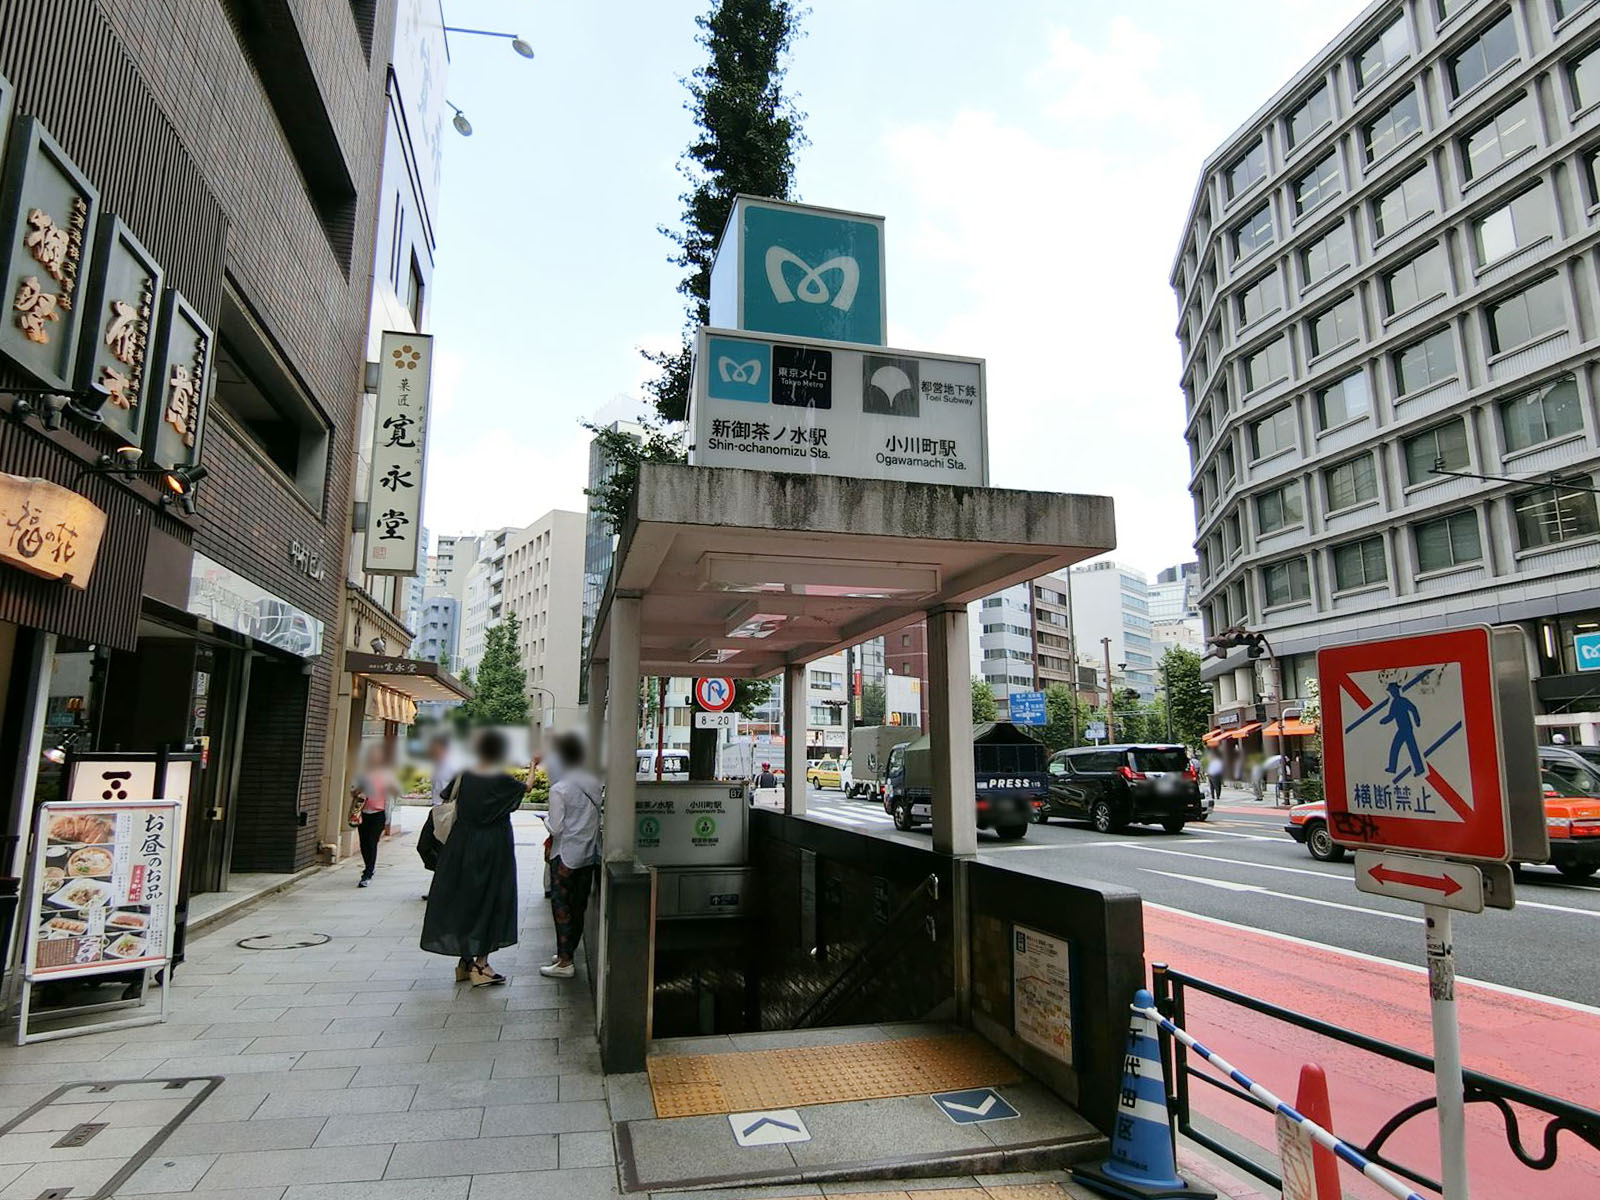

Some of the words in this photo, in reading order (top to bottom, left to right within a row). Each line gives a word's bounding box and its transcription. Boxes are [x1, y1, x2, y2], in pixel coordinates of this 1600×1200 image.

[778, 366, 827, 381] 東京メトロ
[781, 377, 802, 387] Tokyo
[802, 380, 824, 389] Metro
[398, 378, 411, 407] 菓匠
[921, 381, 977, 398] 都営地下鉄
[925, 393, 942, 402] Toei
[943, 395, 973, 406] Subway
[711, 418, 828, 447] 新御茶ノ水駅
[708, 437, 807, 457] Shin-ochanomizu
[809, 446, 831, 459] Sta.
[885, 435, 957, 457] 小川町駅
[875, 452, 944, 467] Ogawamachi
[947, 458, 967, 470] Sta.
[376, 413, 416, 541] 寛永堂
[730, 788, 742, 798] B7
[988, 778, 1031, 789] PRESS
[1353, 782, 1437, 815] 横断禁止
[139, 813, 166, 901] お昼のお品
[1117, 1027, 1144, 1142] 千代田区
